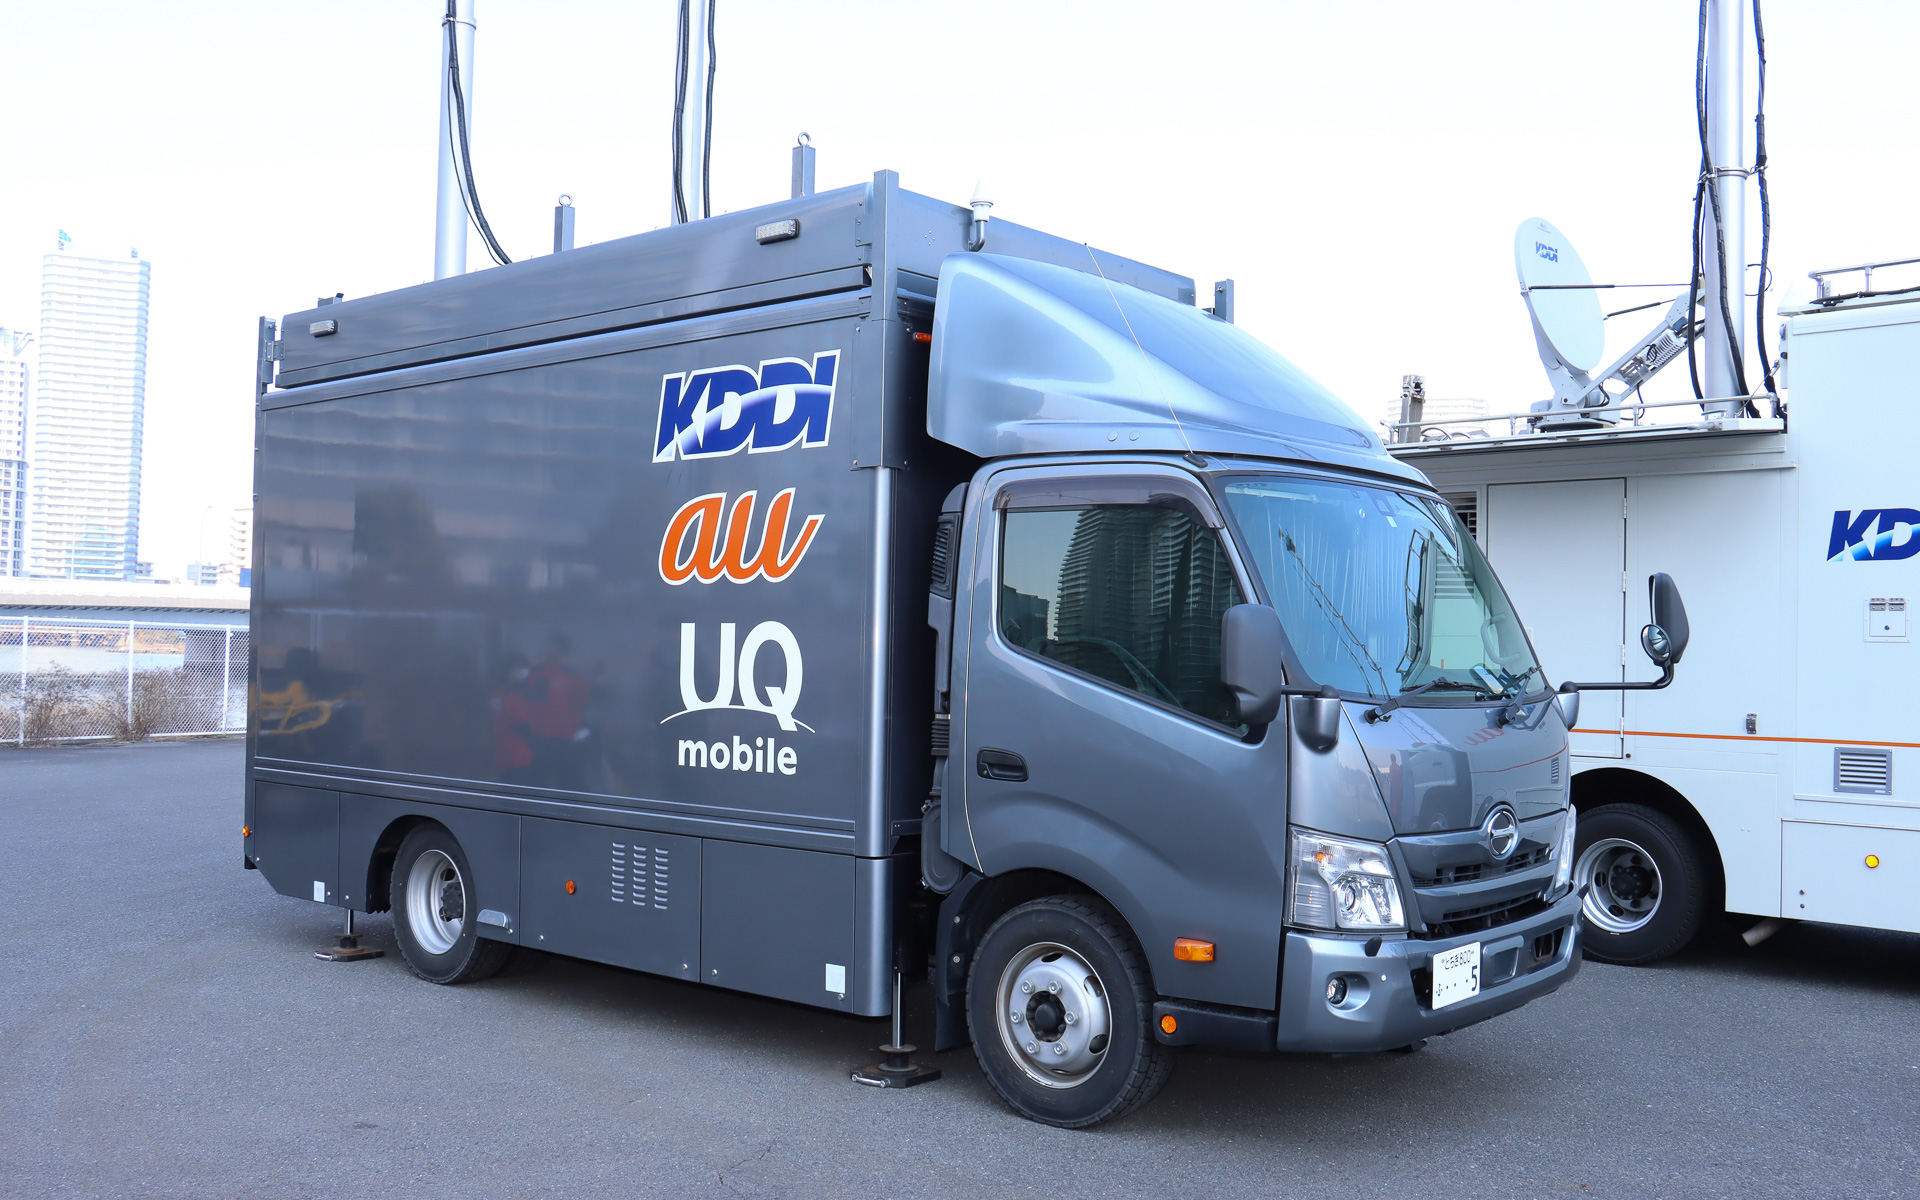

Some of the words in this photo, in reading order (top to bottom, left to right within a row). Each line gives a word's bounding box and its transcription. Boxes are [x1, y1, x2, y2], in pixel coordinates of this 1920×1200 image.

[1535, 240, 1558, 263] KDDI
[652, 349, 841, 463] KDDI
[658, 487, 825, 585] au
[680, 621, 803, 732] UQ
[678, 735, 798, 775] mobile
